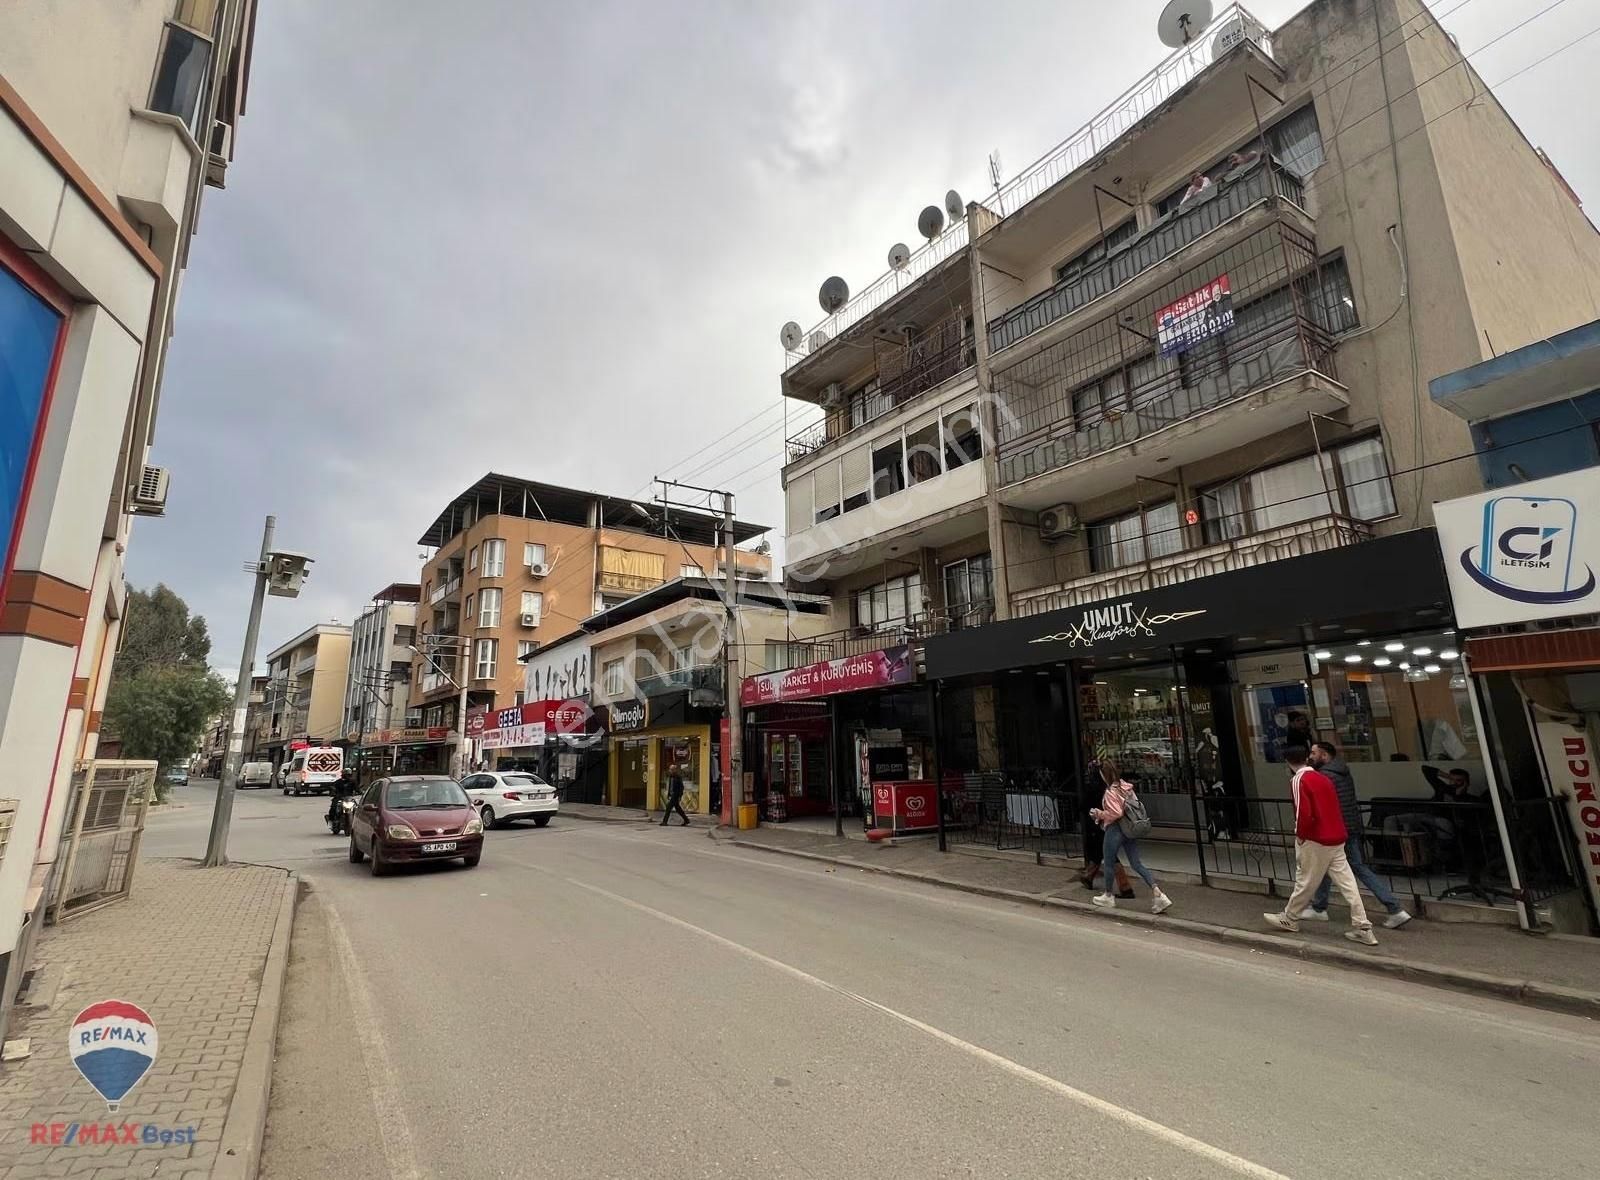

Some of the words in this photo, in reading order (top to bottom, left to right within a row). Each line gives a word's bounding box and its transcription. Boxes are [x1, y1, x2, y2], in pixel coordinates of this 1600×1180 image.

[1084, 602, 1133, 631] UMUT
[1090, 625, 1132, 642] Kuaför
[781, 671, 812, 689] MARKET
[813, 672, 820, 684] &
[821, 659, 874, 683] KURUYEMİŞ
[546, 710, 582, 719] GEETA
[1191, 702, 1211, 712] UMUT
[498, 707, 522, 728] GEETA
